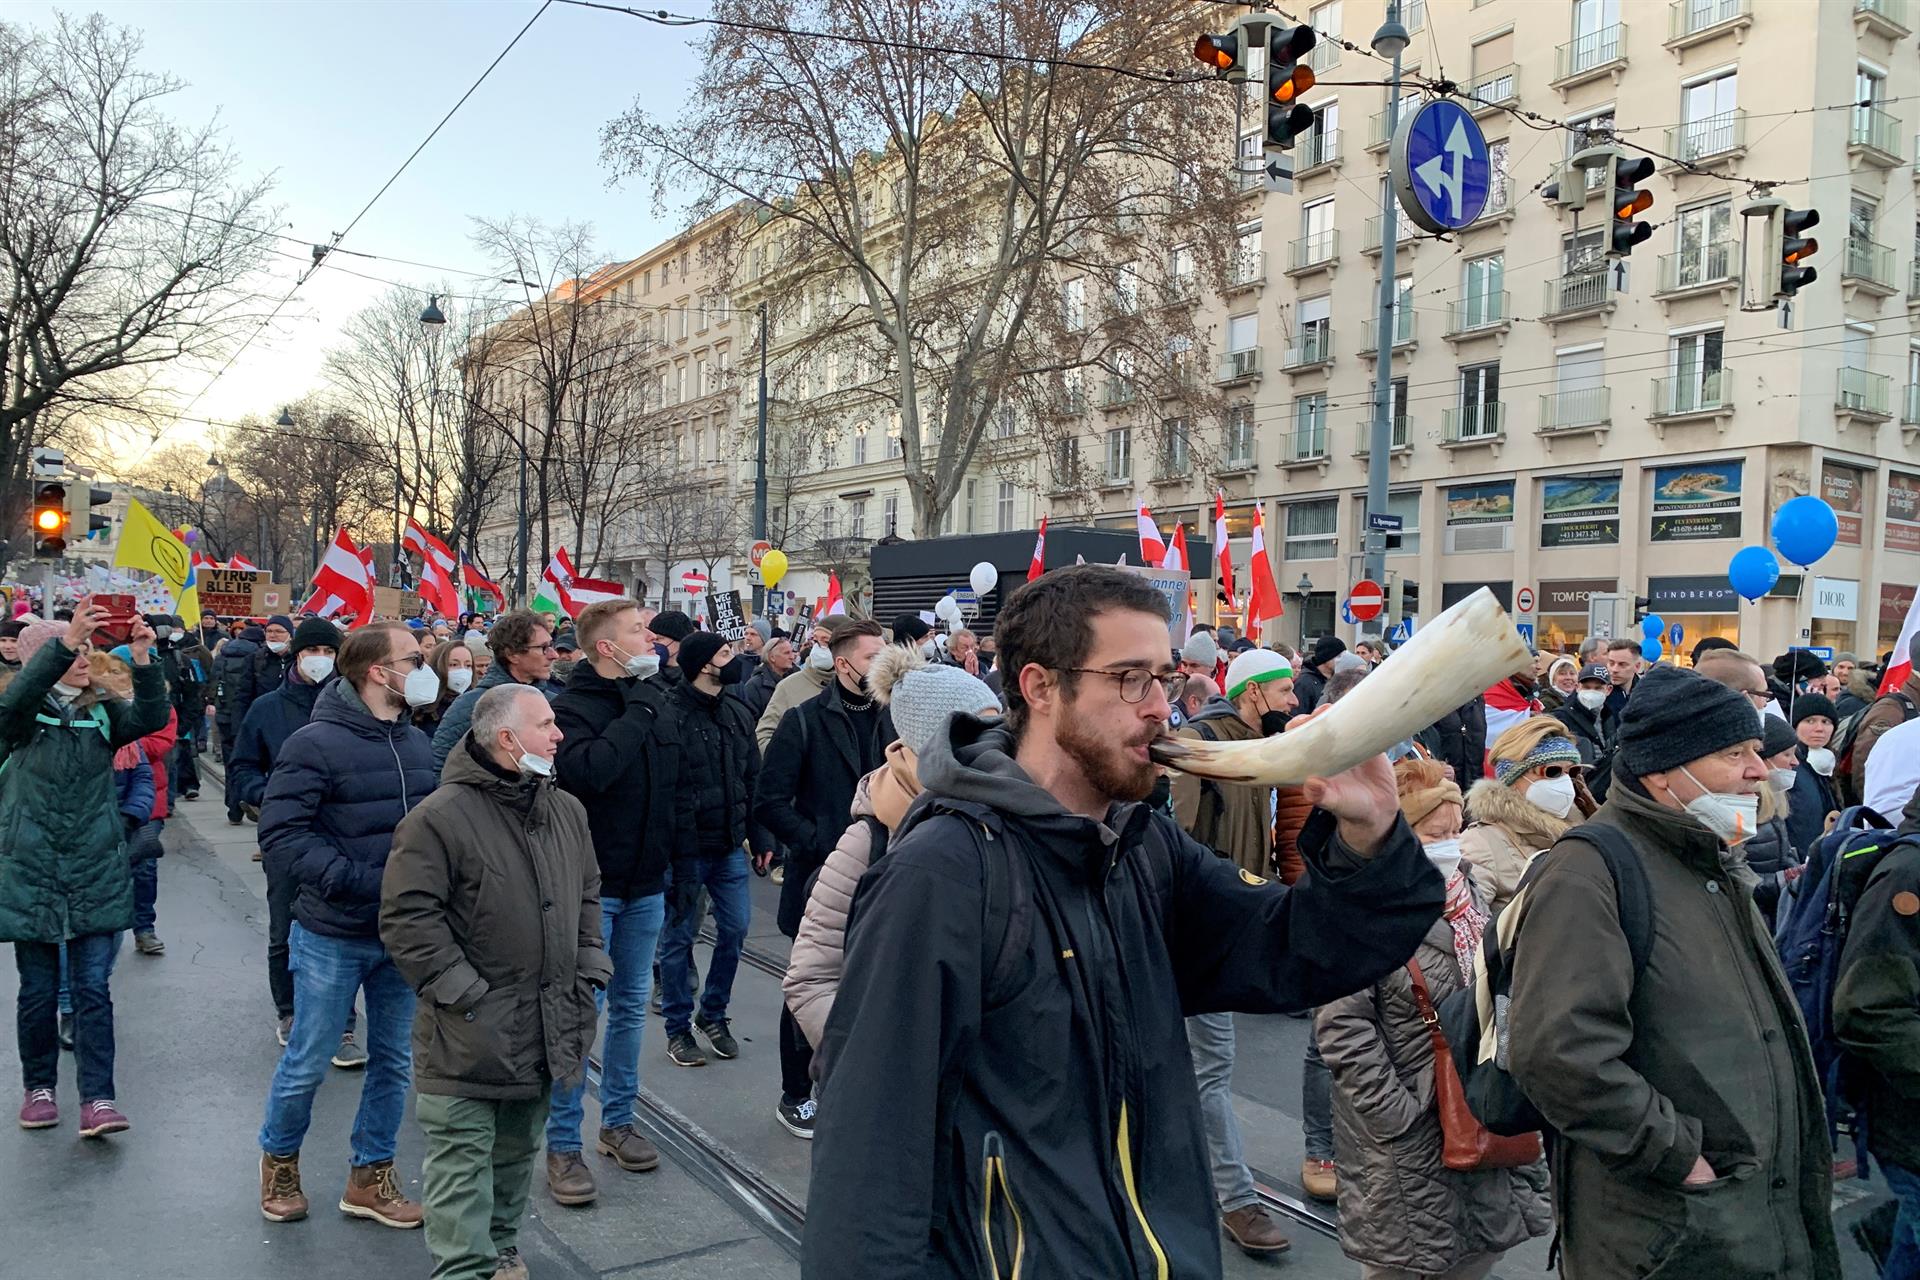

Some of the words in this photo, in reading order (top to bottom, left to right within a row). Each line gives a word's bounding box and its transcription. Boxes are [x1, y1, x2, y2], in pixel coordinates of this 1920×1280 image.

[1824, 476, 1853, 489] CLASSIC
[1827, 488, 1849, 499] MUSIC
[1657, 503, 1697, 511] MONTENEGRO
[211, 569, 258, 582] VIRUS
[206, 581, 252, 593] BLEIB
[713, 592, 732, 604] WEG
[1551, 592, 1575, 602] TOM
[1656, 590, 1723, 599] LINDBERG
[1819, 590, 1846, 608] DIOR
[715, 600, 731, 611] MIT
[718, 608, 734, 620] DER
[715, 615, 742, 631] GIFT-
